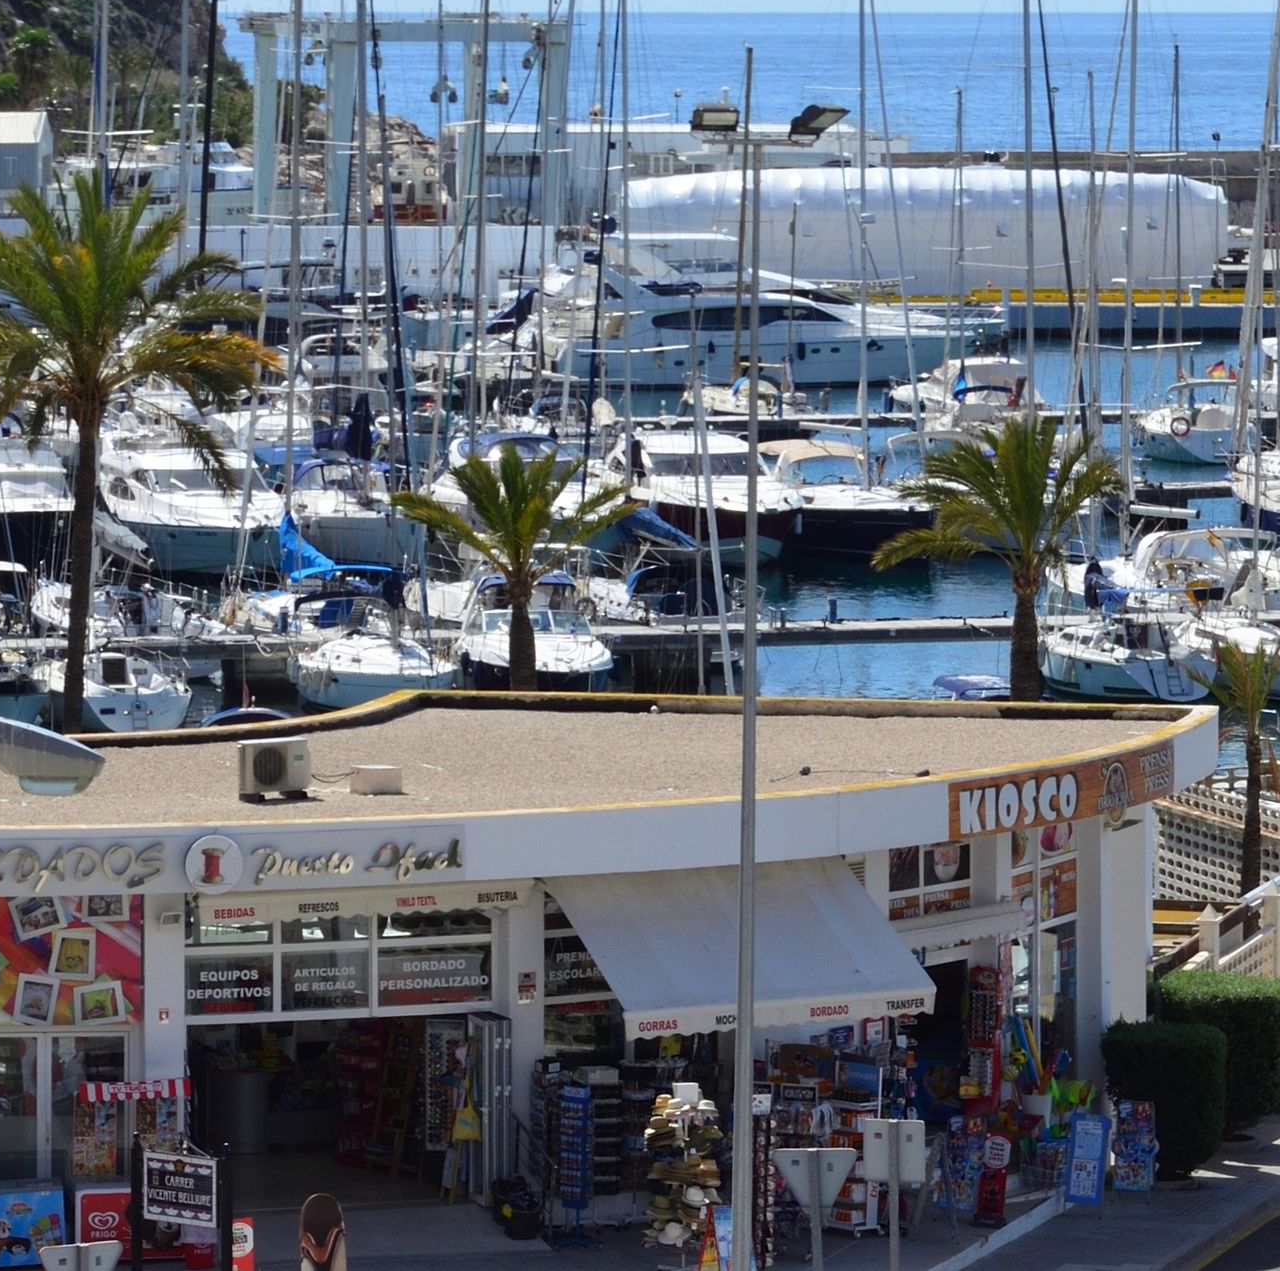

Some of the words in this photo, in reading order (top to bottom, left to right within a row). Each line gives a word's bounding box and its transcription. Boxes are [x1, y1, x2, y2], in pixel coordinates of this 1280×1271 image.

[1139, 748, 1174, 773] PRENSA
[1144, 771, 1170, 794] PRESS
[959, 773, 1078, 835] KIOSCO
[251, 846, 354, 886] Puerto
[395, 896, 416, 908] VINILO
[417, 895, 438, 907] TEXTIL
[477, 891, 518, 904] BISUTERIA
[214, 907, 256, 920] BEBIDAS
[298, 901, 340, 914] REFRESCOS
[294, 966, 356, 978] ARTICULOS
[402, 959, 467, 972] BORDADO
[200, 969, 259, 983] EQUIPOS
[379, 975, 490, 991] PERSONALIZADO
[187, 986, 272, 1000] DEPORTIVOS
[294, 982, 310, 993] DE
[311, 980, 356, 992] REGALO
[809, 1004, 849, 1018] BORDADO
[886, 997, 926, 1011] TRANSFER
[638, 1019, 678, 1033] GORRAS
[164, 1175, 194, 1189] CARRER
[147, 1188, 177, 1203] VICENTE
[178, 1191, 211, 1207] BELLIURE
[91, 1231, 116, 1240] FRIGO
